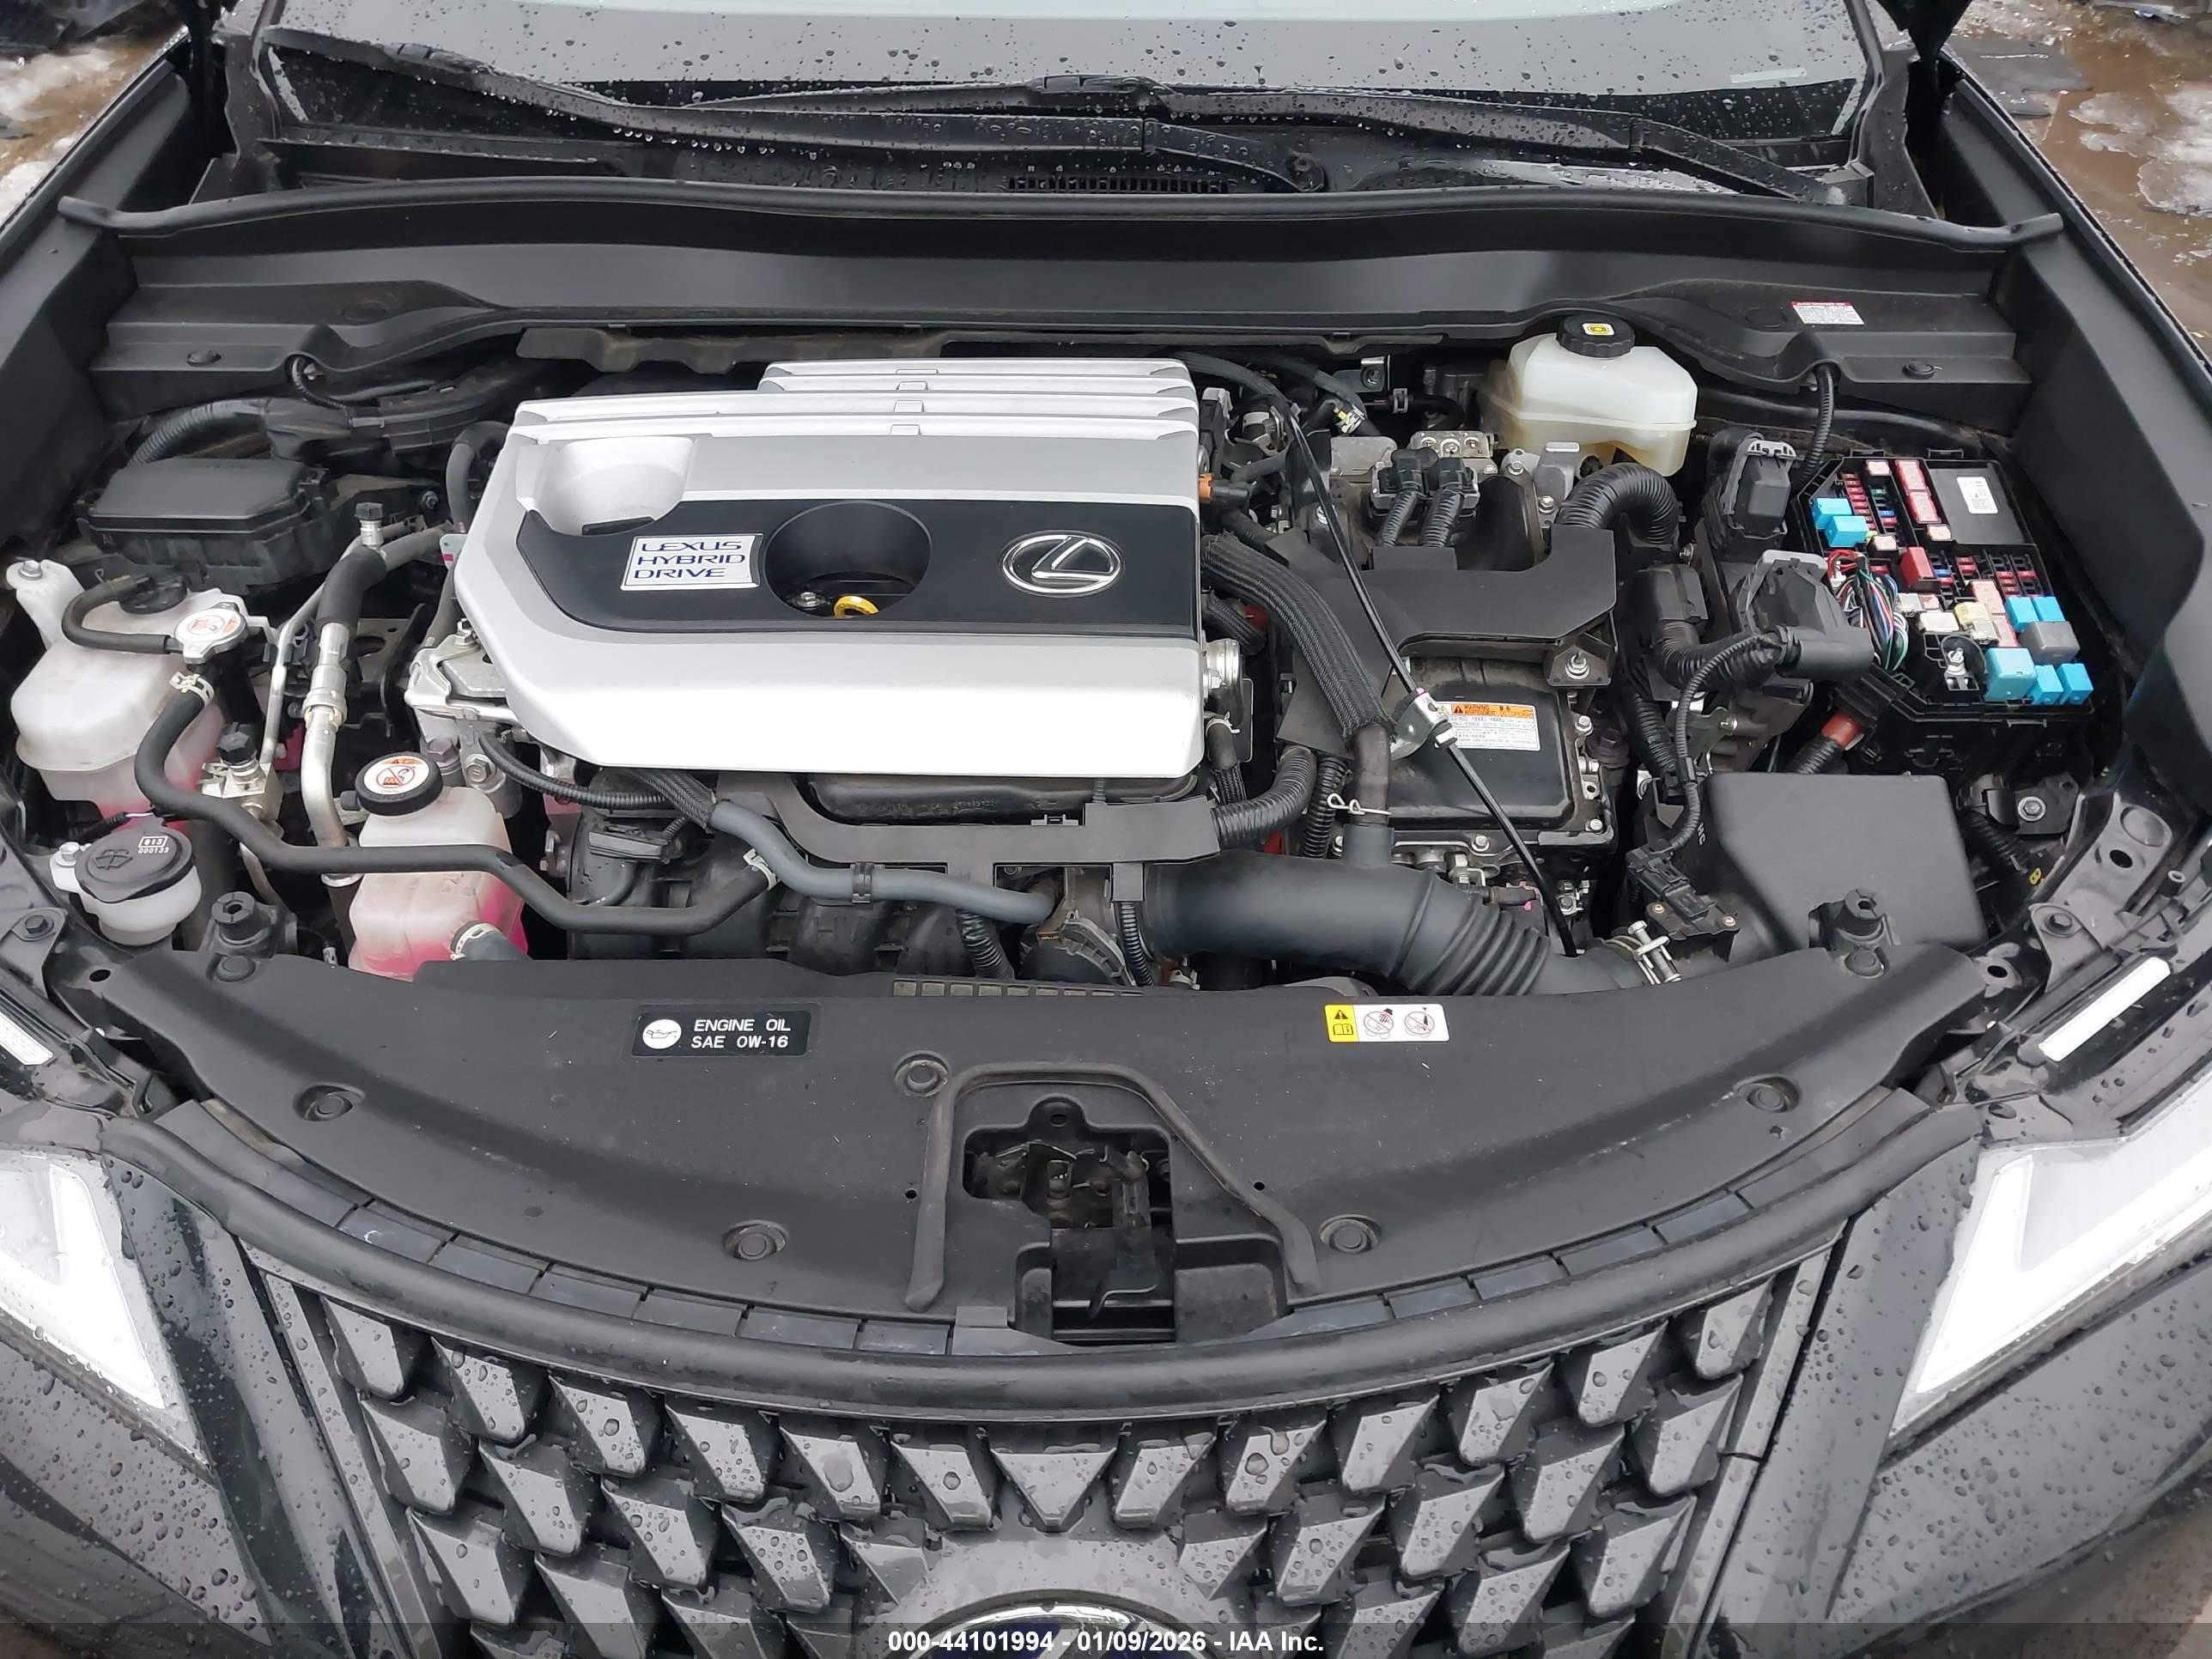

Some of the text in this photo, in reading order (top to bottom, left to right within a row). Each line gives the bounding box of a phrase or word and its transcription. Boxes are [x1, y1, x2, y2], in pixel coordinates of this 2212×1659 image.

[641, 541, 742, 552] LEXUS
[637, 554, 745, 565] HYBRID
[634, 568, 726, 579] DRIVE
[694, 1018, 791, 1032] ENGINE OIL
[690, 1036, 789, 1048] SAE 0W-16
